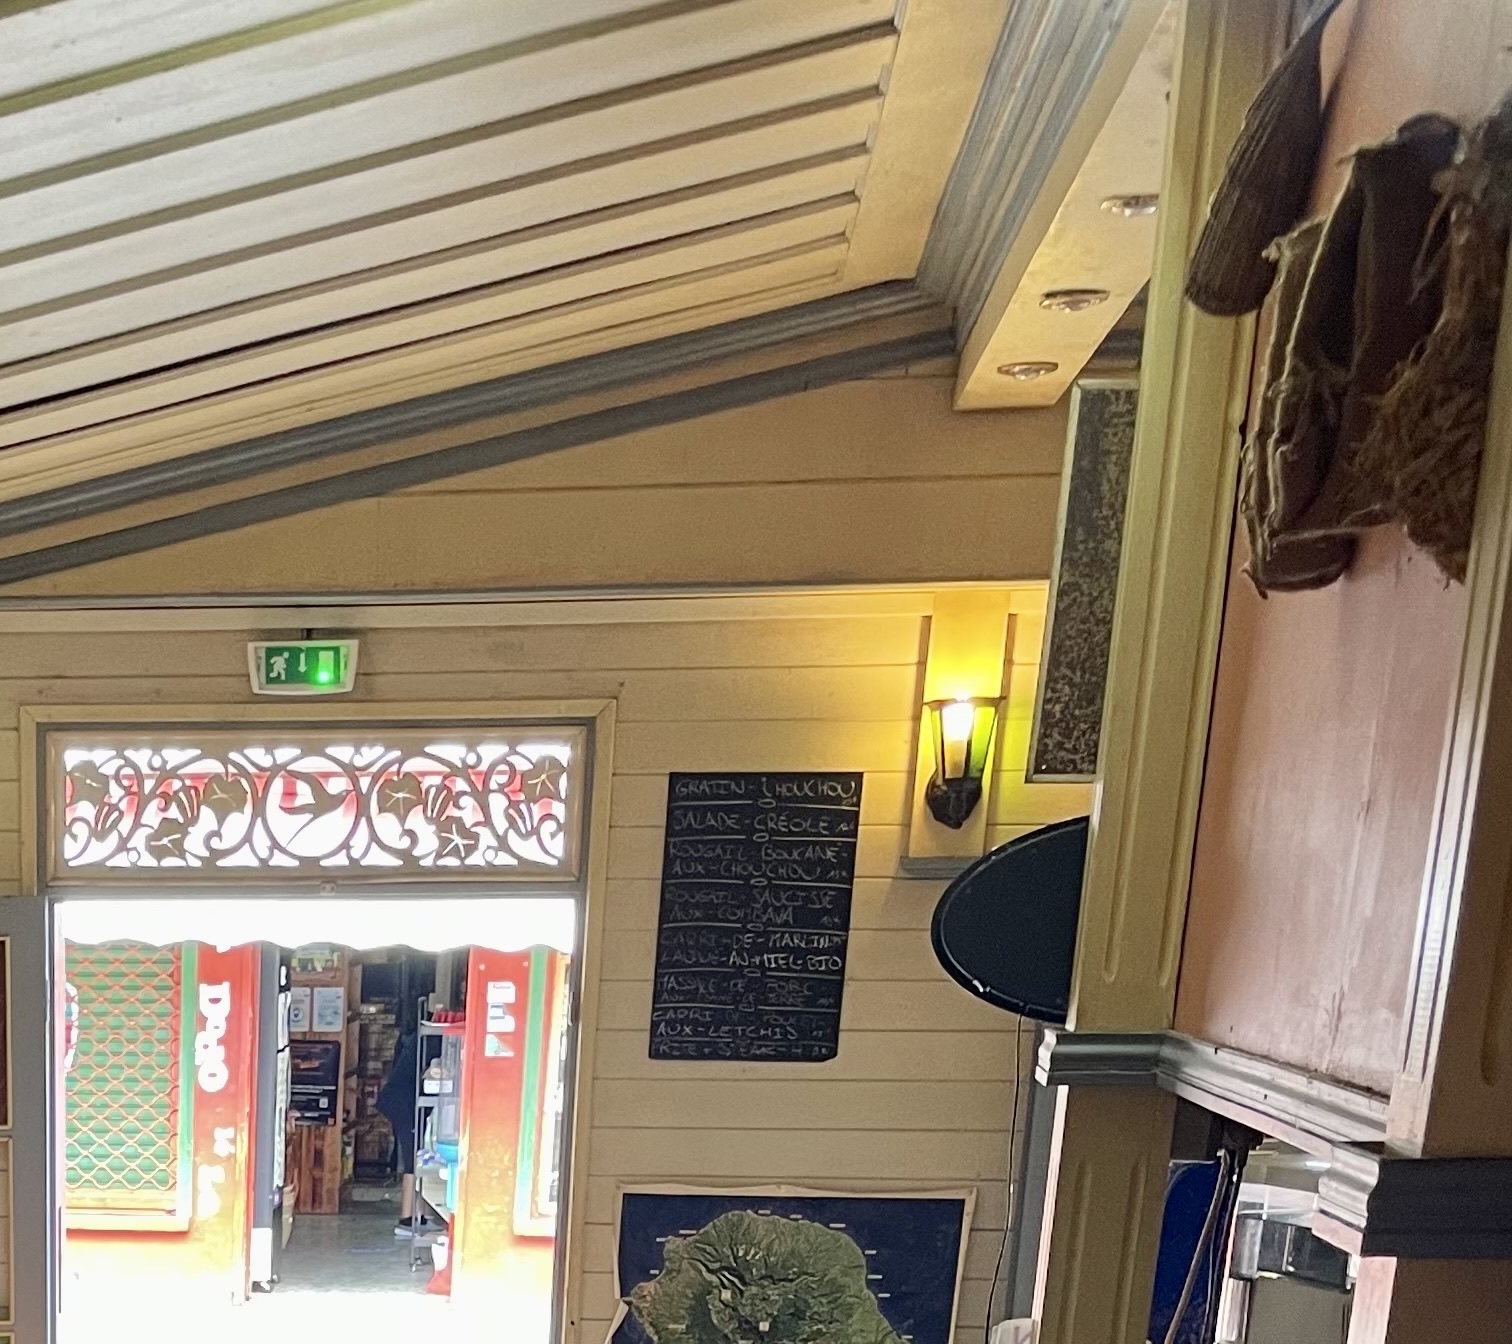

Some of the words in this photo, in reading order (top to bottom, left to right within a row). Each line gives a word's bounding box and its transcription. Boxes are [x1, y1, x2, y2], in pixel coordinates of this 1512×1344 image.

[675, 780, 745, 795] GRATIN
[761, 777, 855, 798] CHOUCHOU
[672, 811, 741, 831] SALADE
[672, 859, 705, 875] AUX
[720, 862, 821, 881] CHOUCHOU
[732, 933, 755, 949] DE
[806, 955, 842, 971] BIO
[656, 1021, 694, 1037] AUX
